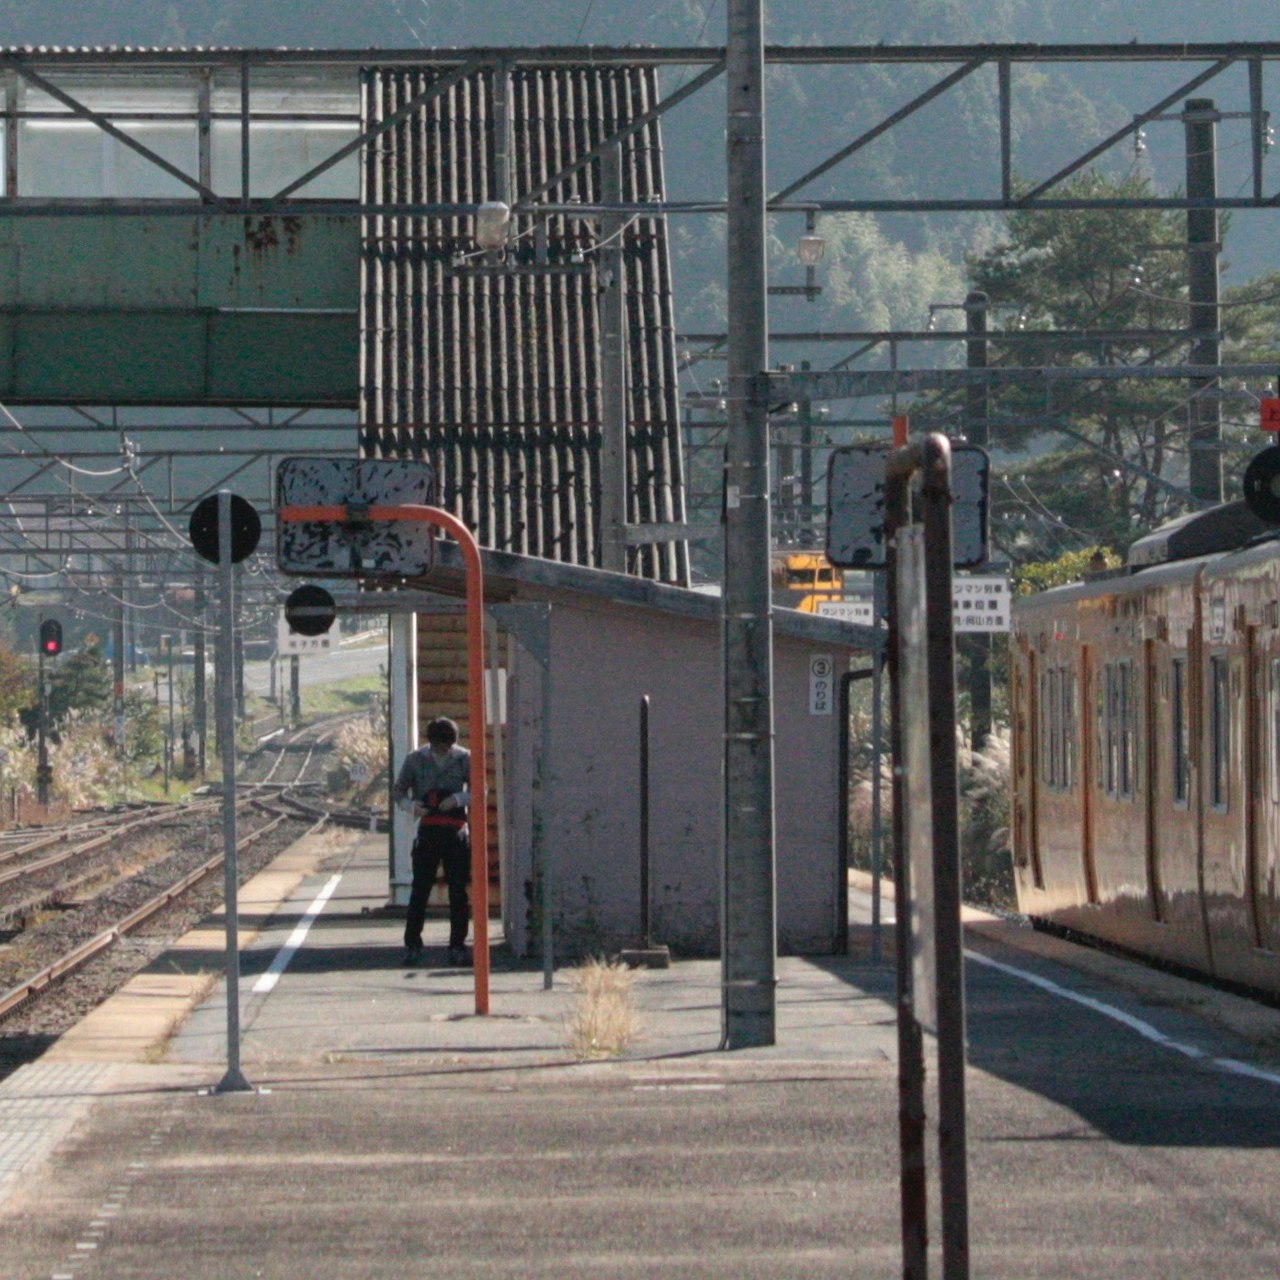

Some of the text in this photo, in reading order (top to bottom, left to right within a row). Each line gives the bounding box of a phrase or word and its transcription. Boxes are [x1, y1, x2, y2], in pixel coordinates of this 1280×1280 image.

[953, 584, 1002, 594] ンマン列車
